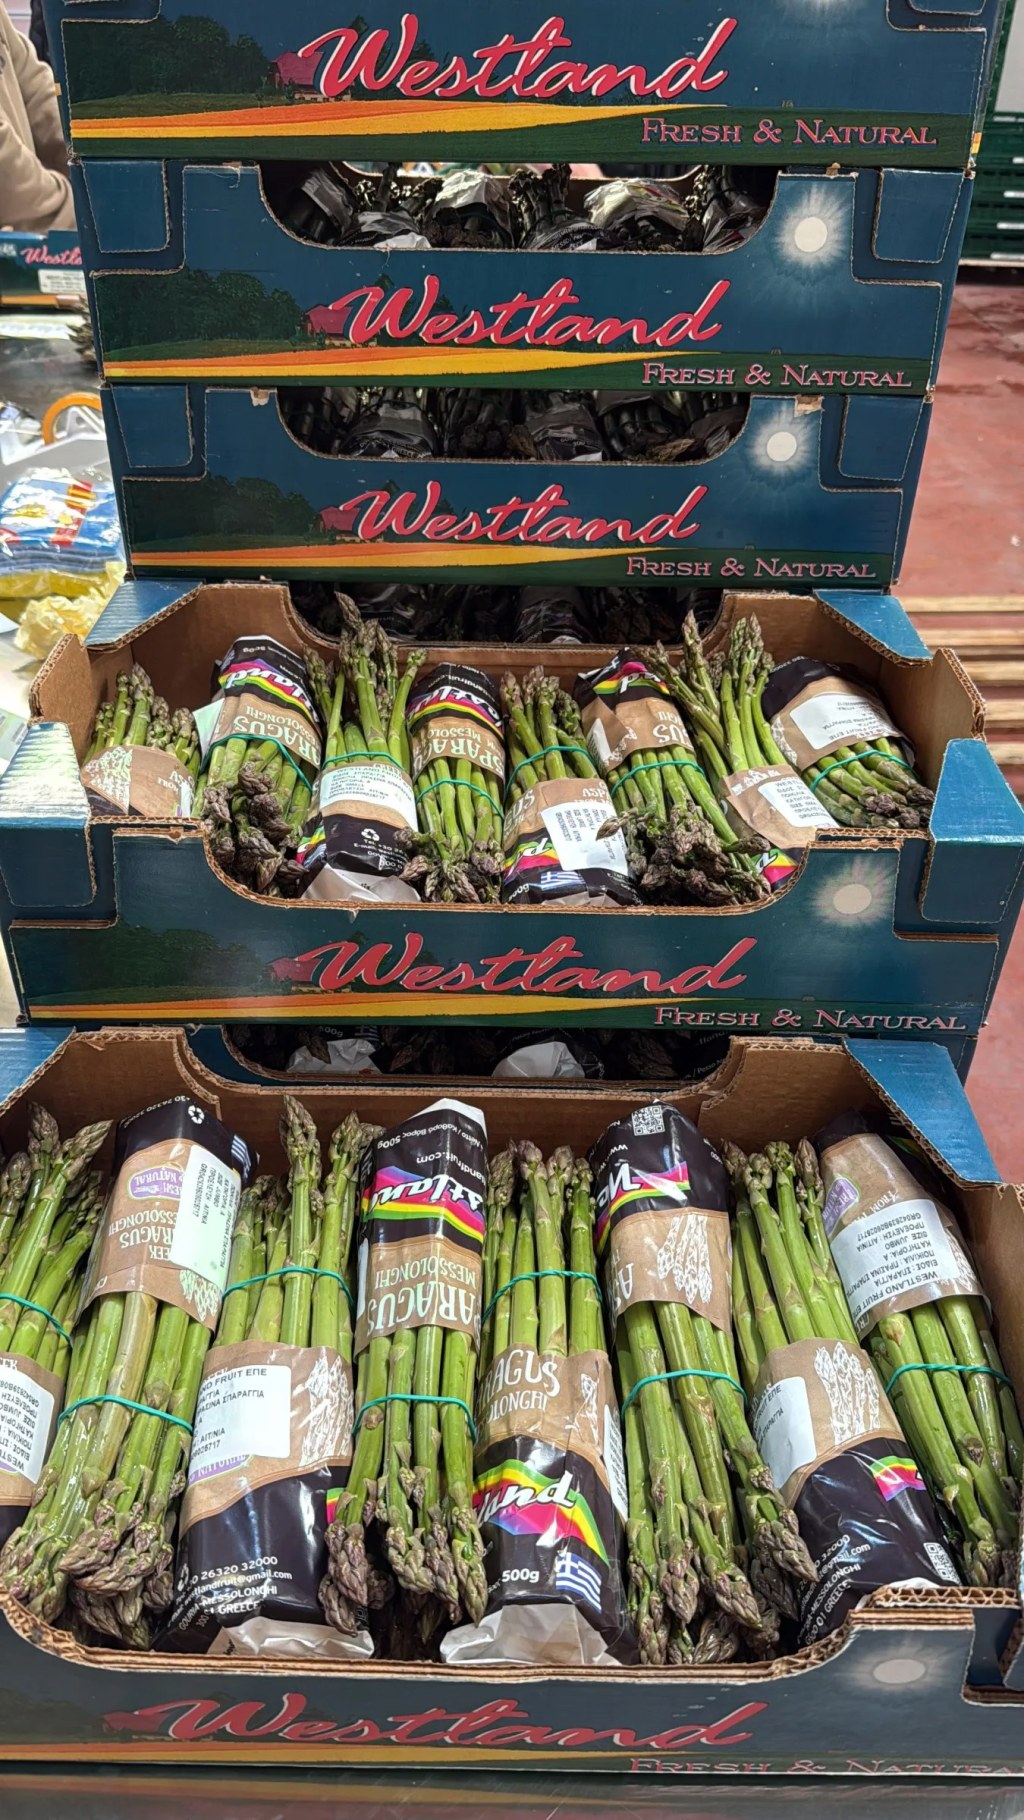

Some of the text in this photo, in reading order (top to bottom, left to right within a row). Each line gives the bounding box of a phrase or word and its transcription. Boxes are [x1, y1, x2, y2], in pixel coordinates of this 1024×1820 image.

[298, 13, 737, 98] Westland
[641, 117, 937, 145] FRESH & NATURAL
[329, 274, 730, 347] Westland
[642, 362, 912, 388] FRESH & NATURAL
[340, 480, 707, 544] Westland
[626, 556, 876, 578] FRESH & NATURAL
[294, 932, 757, 994] Westland
[654, 1007, 966, 1030] FRESH & NATURAL
[884, 1235, 909, 1250] JUMBO
[374, 1255, 477, 1290] MESSOLONGHI
[885, 1270, 939, 1295] WESTLAND
[861, 1289, 884, 1309] FRUIT
[200, 1556, 278, 1581] 26320 32000
[501, 1568, 540, 1583] 500g
[134, 1692, 770, 1749] Westland
[846, 1760, 1024, 1775] NATURA
